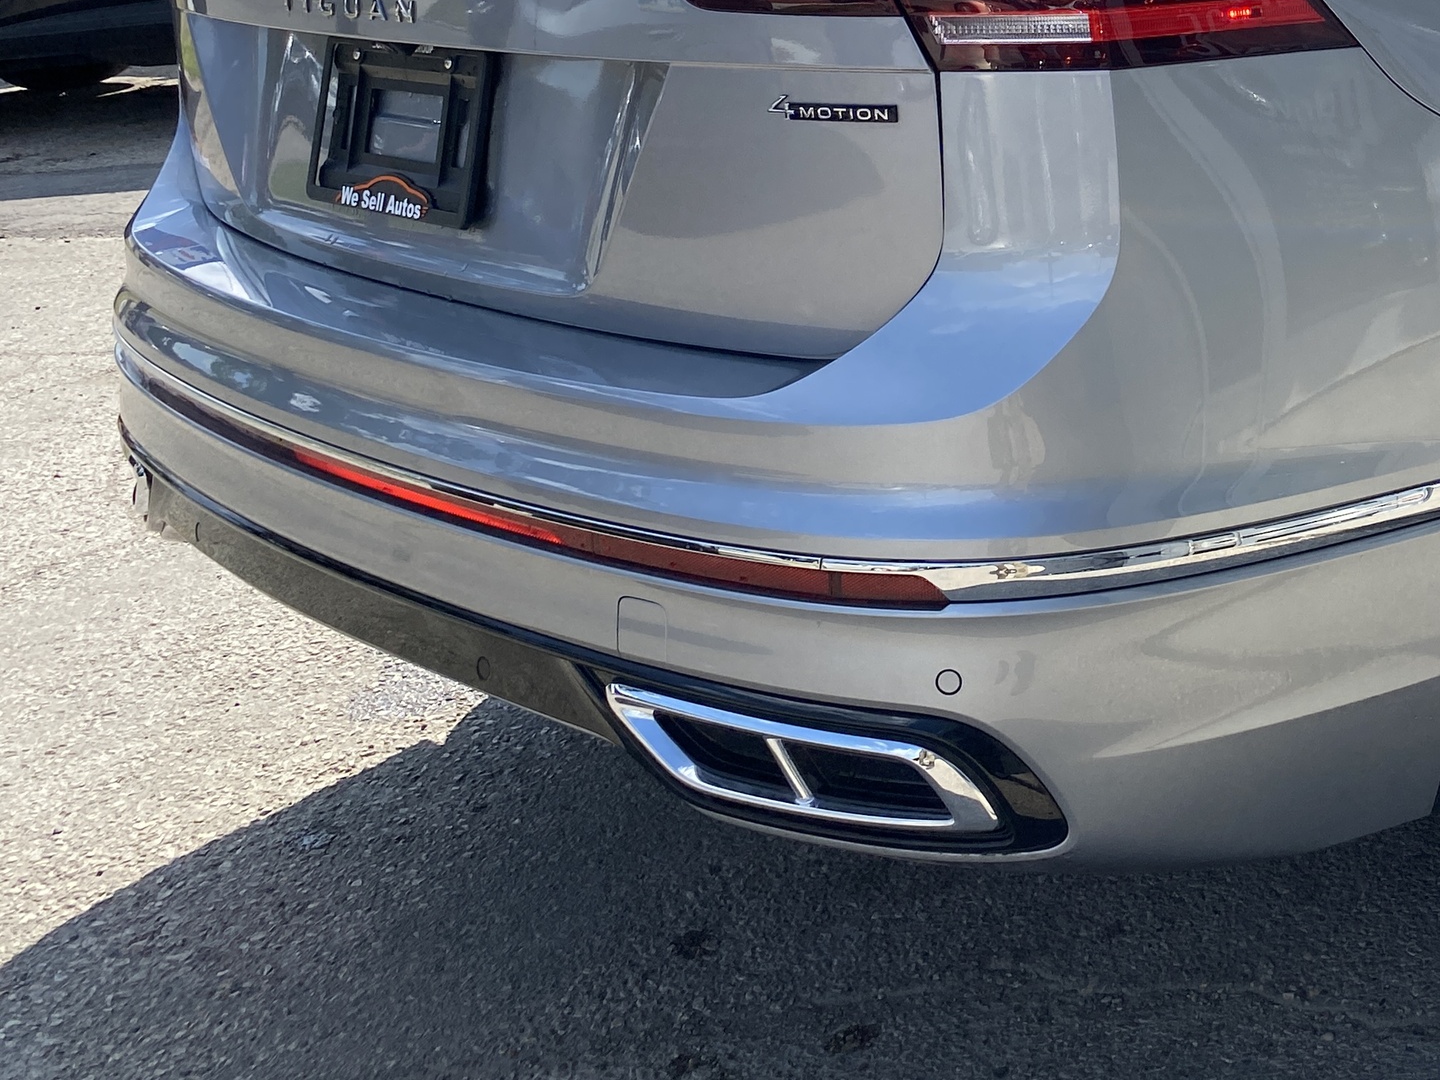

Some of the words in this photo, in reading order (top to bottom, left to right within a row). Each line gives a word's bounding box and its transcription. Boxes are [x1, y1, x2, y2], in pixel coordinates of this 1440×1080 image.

[767, 94, 890, 120] 4MOTION
[340, 184, 359, 207] We
[360, 186, 386, 212] Sell
[385, 197, 422, 220] Autos
